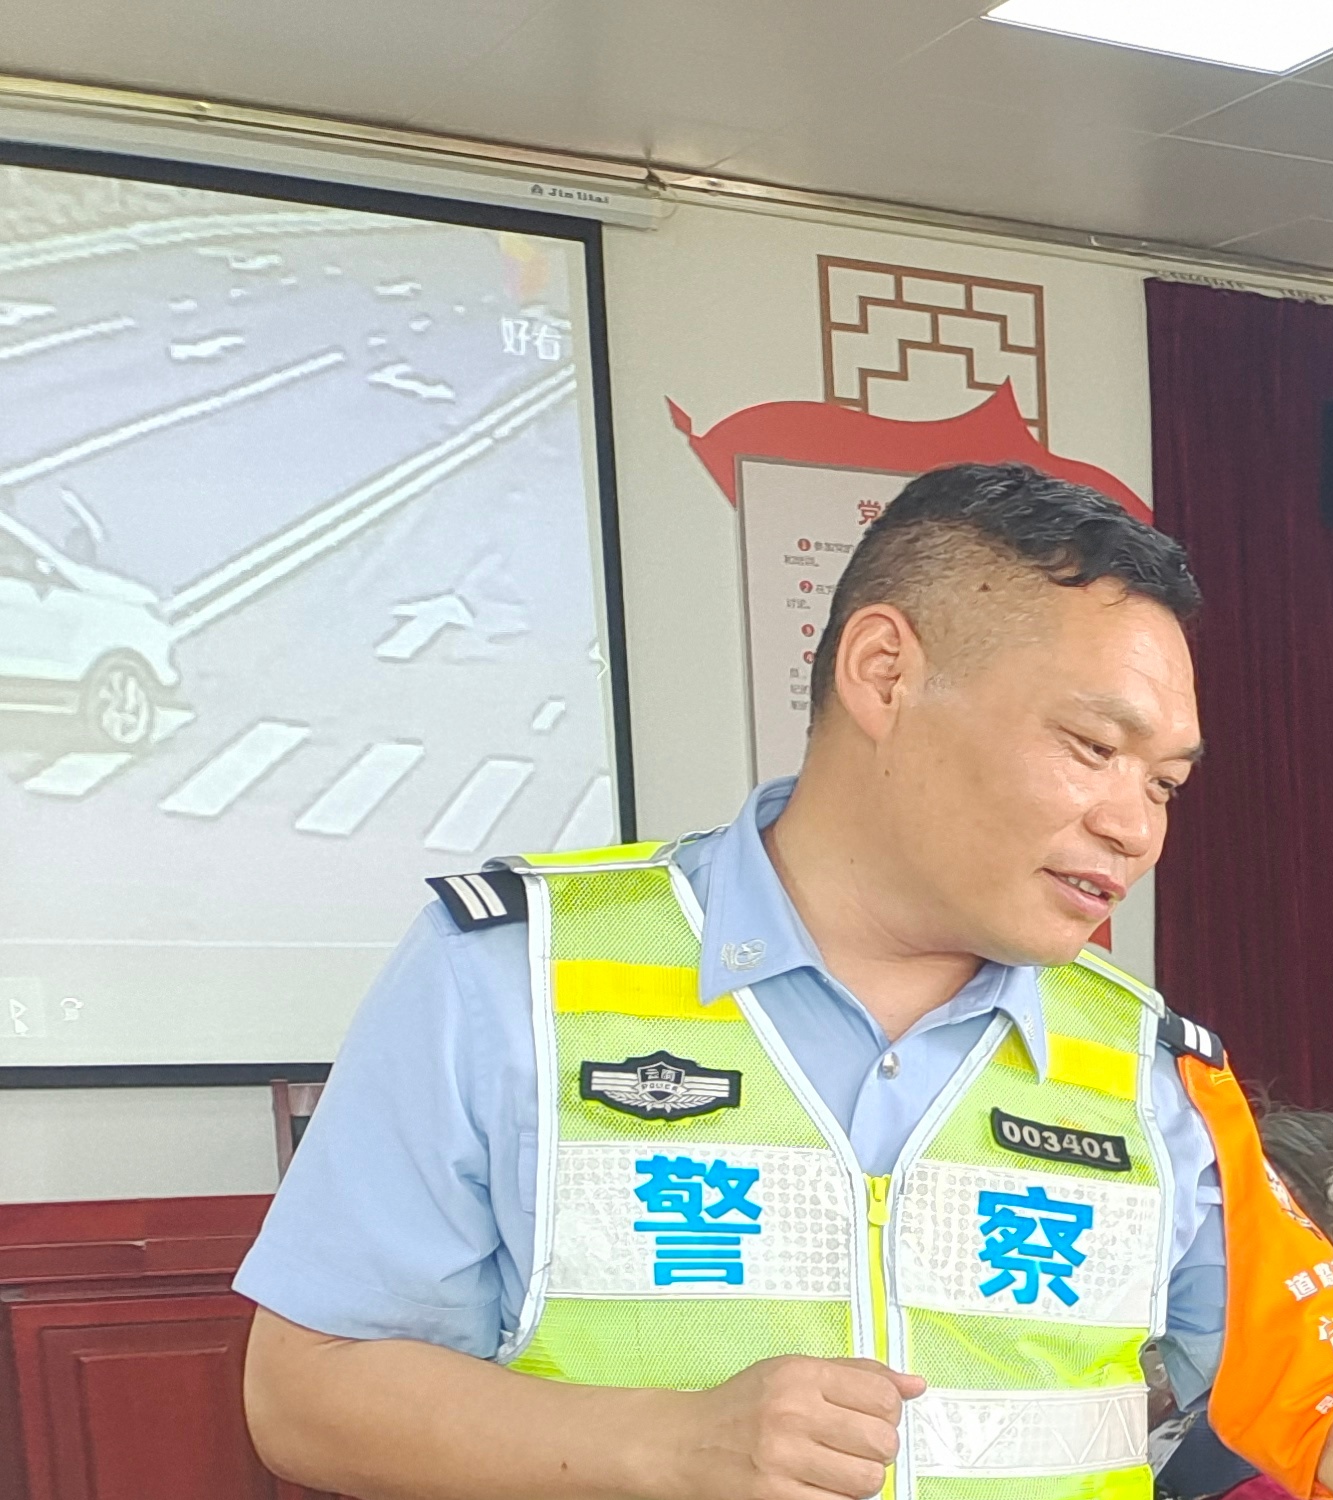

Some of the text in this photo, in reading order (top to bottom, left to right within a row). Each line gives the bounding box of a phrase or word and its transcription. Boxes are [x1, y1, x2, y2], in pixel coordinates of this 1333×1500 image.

[641, 1083, 680, 1093] POLICE
[1001, 1121, 1121, 1163] 003401
[632, 1154, 1094, 1308] 警 察
